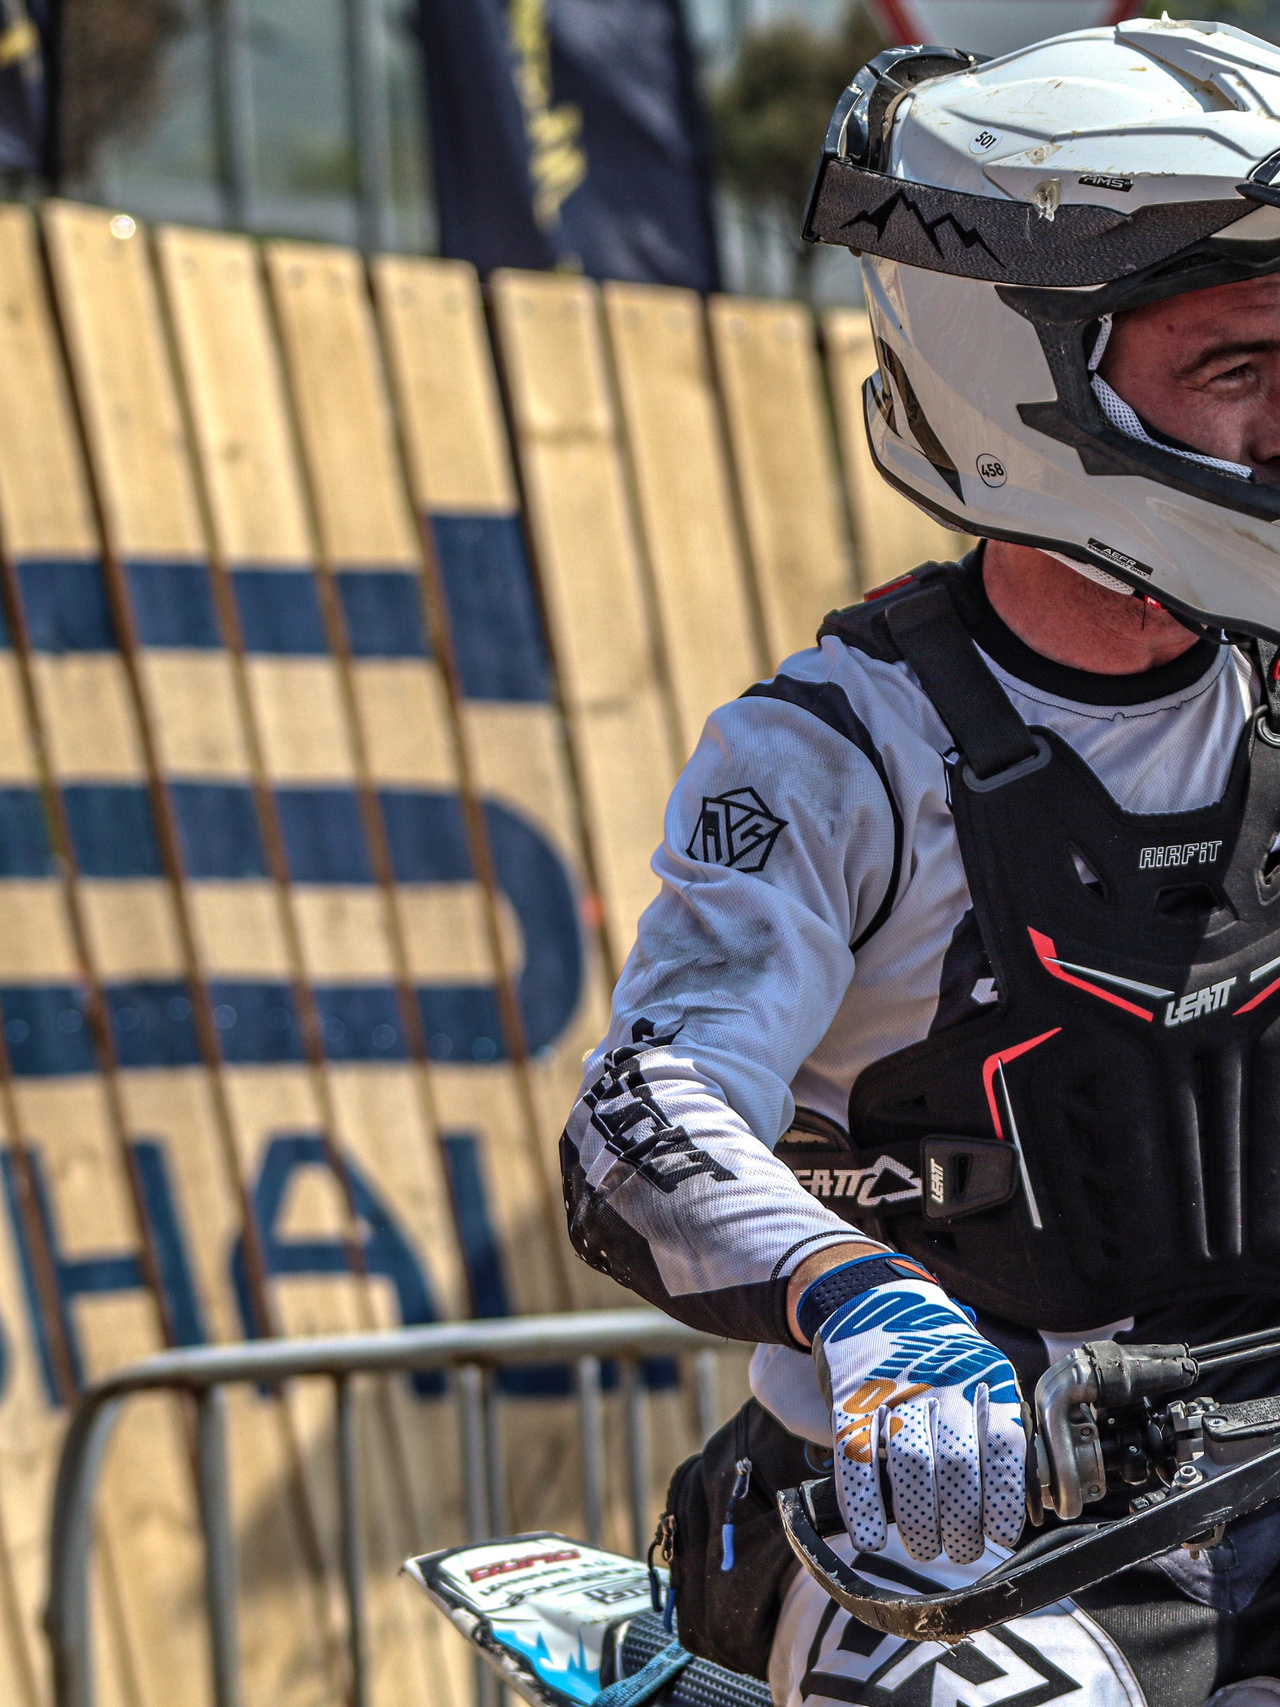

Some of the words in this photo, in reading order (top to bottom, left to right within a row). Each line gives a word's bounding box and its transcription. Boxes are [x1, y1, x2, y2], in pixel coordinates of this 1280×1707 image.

[975, 131, 997, 149] 501
[981, 462, 1005, 478] 458
[1103, 548, 1137, 566] AEFR
[1164, 976, 1237, 1028] LEATT
[930, 1157, 944, 1204] LEATT
